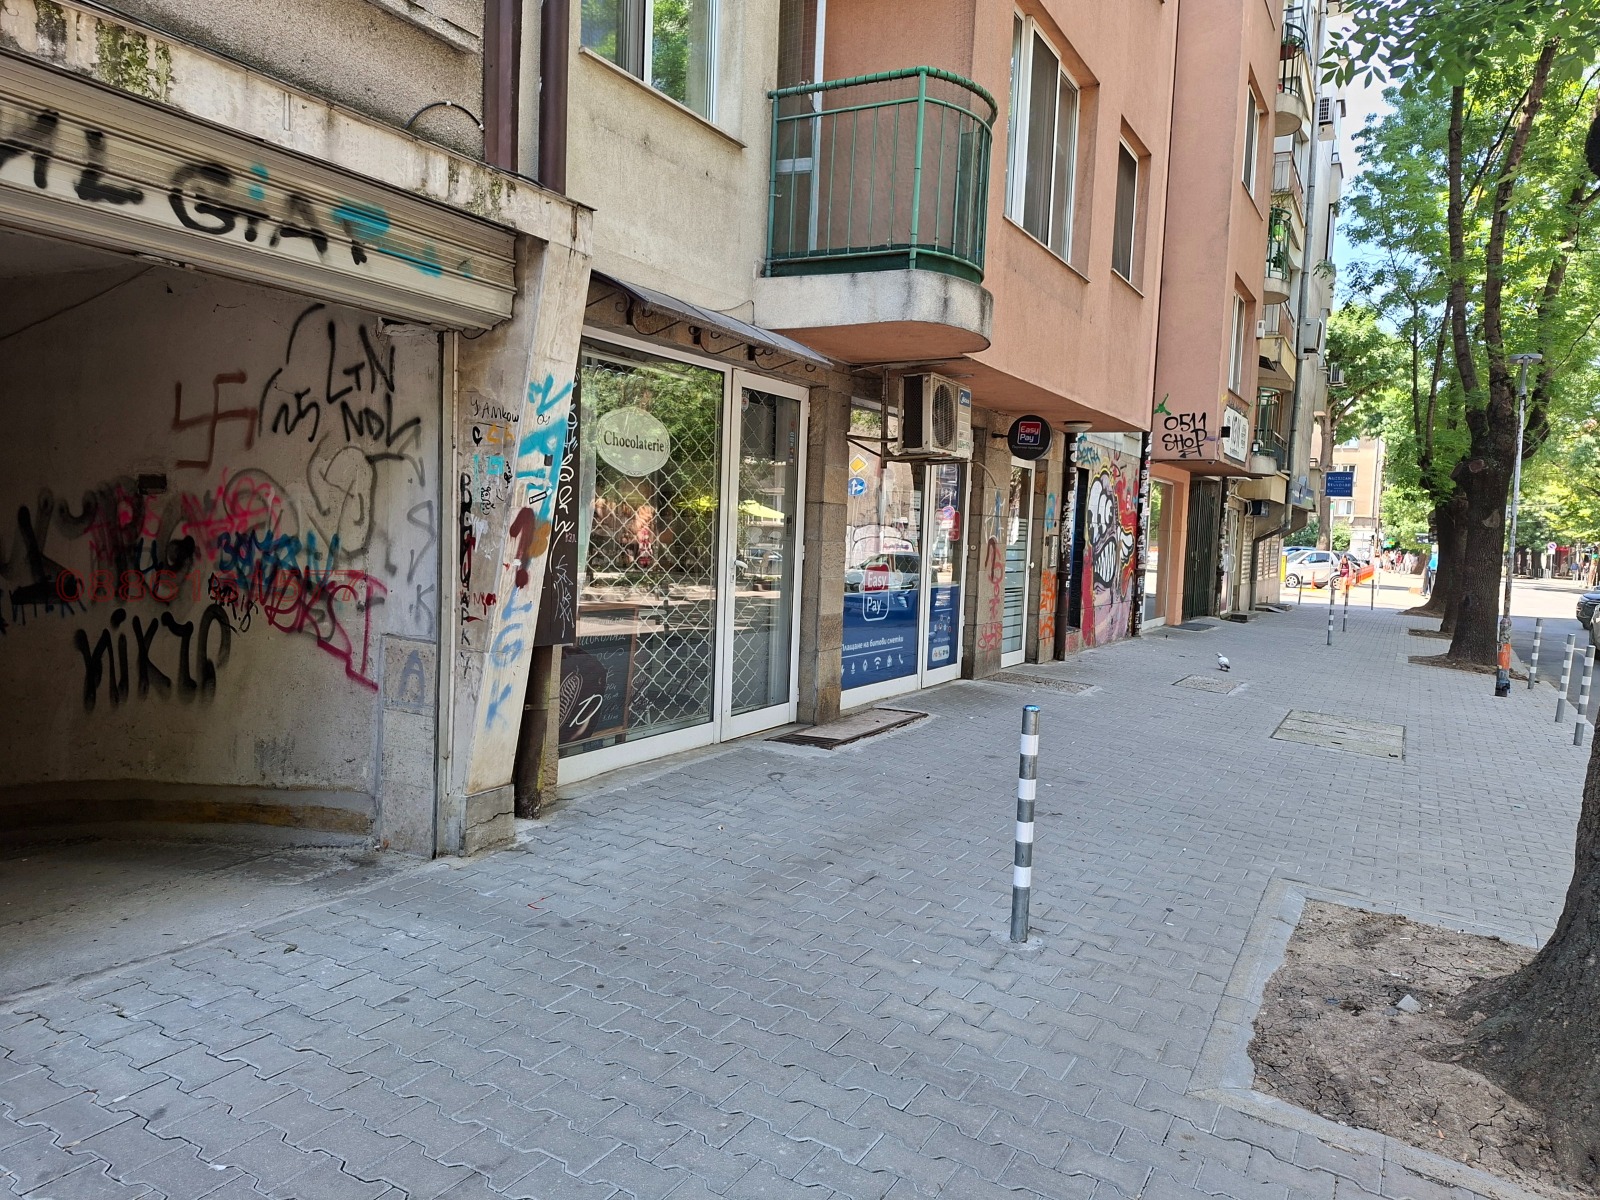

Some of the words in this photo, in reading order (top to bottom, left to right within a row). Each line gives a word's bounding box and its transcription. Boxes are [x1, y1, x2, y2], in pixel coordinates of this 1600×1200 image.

[1020, 425, 1039, 436] Easy
[1020, 434, 1035, 443] Pay
[603, 430, 665, 453] Chocolaterie
[867, 571, 887, 590] Easy
[867, 596, 882, 615] Pay
